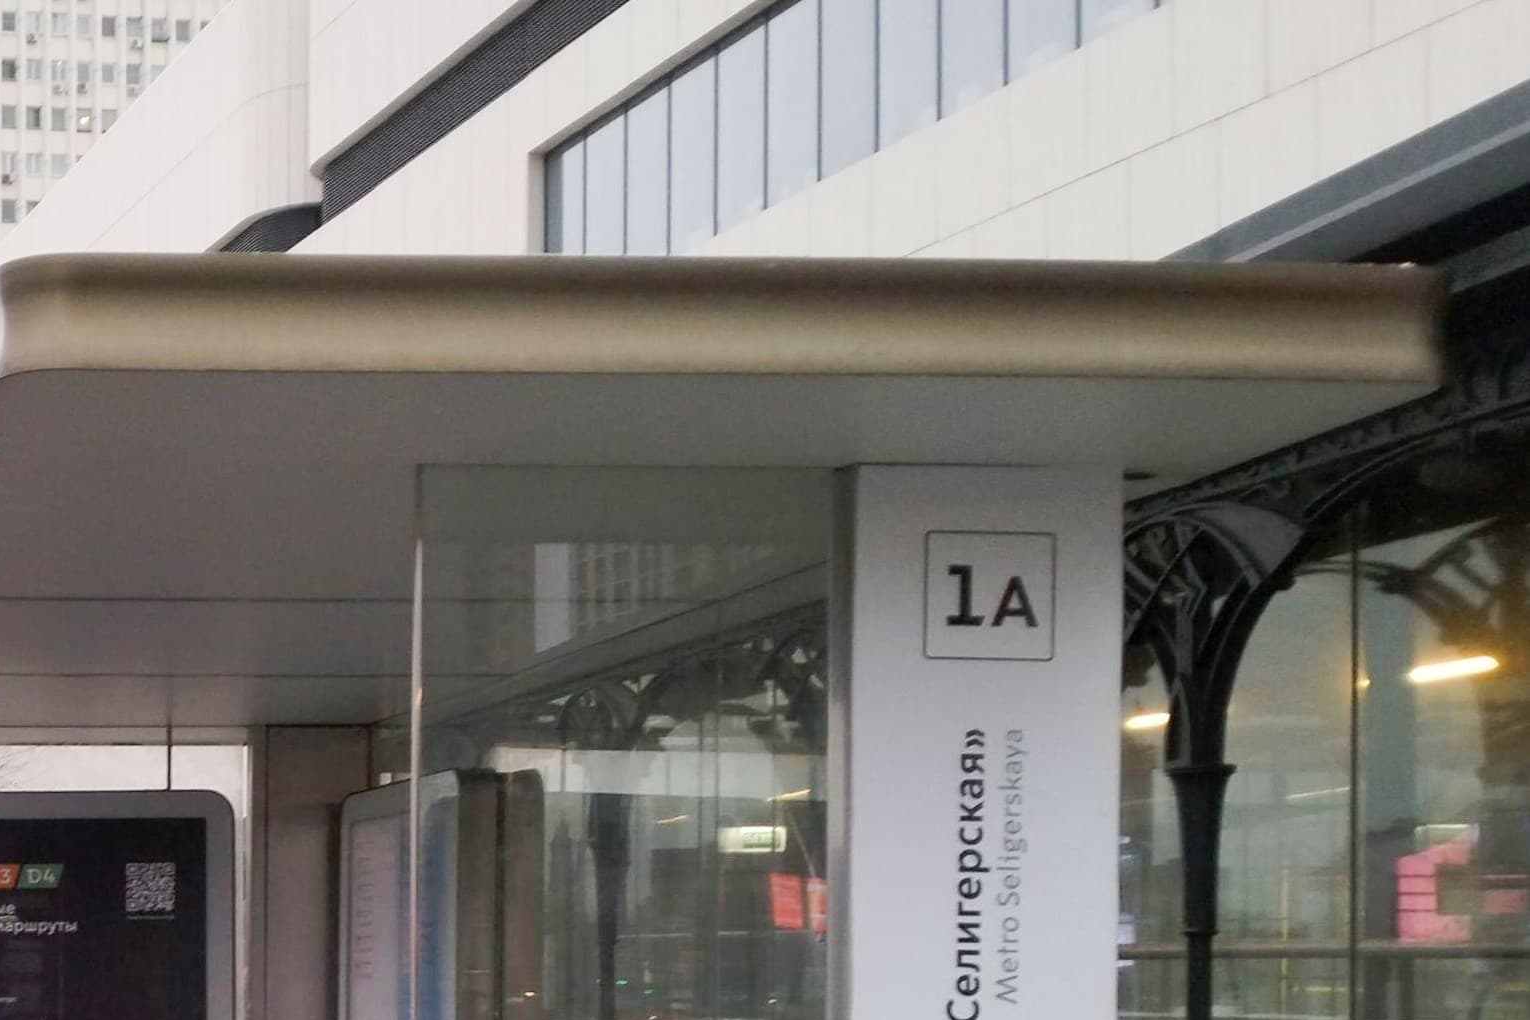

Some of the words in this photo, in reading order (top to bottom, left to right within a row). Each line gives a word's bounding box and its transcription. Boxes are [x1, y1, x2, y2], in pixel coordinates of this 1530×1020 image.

[994, 728, 1025, 907] Seligerskaya
[26, 868, 57, 884] D4
[994, 916, 1022, 1005] Metro
